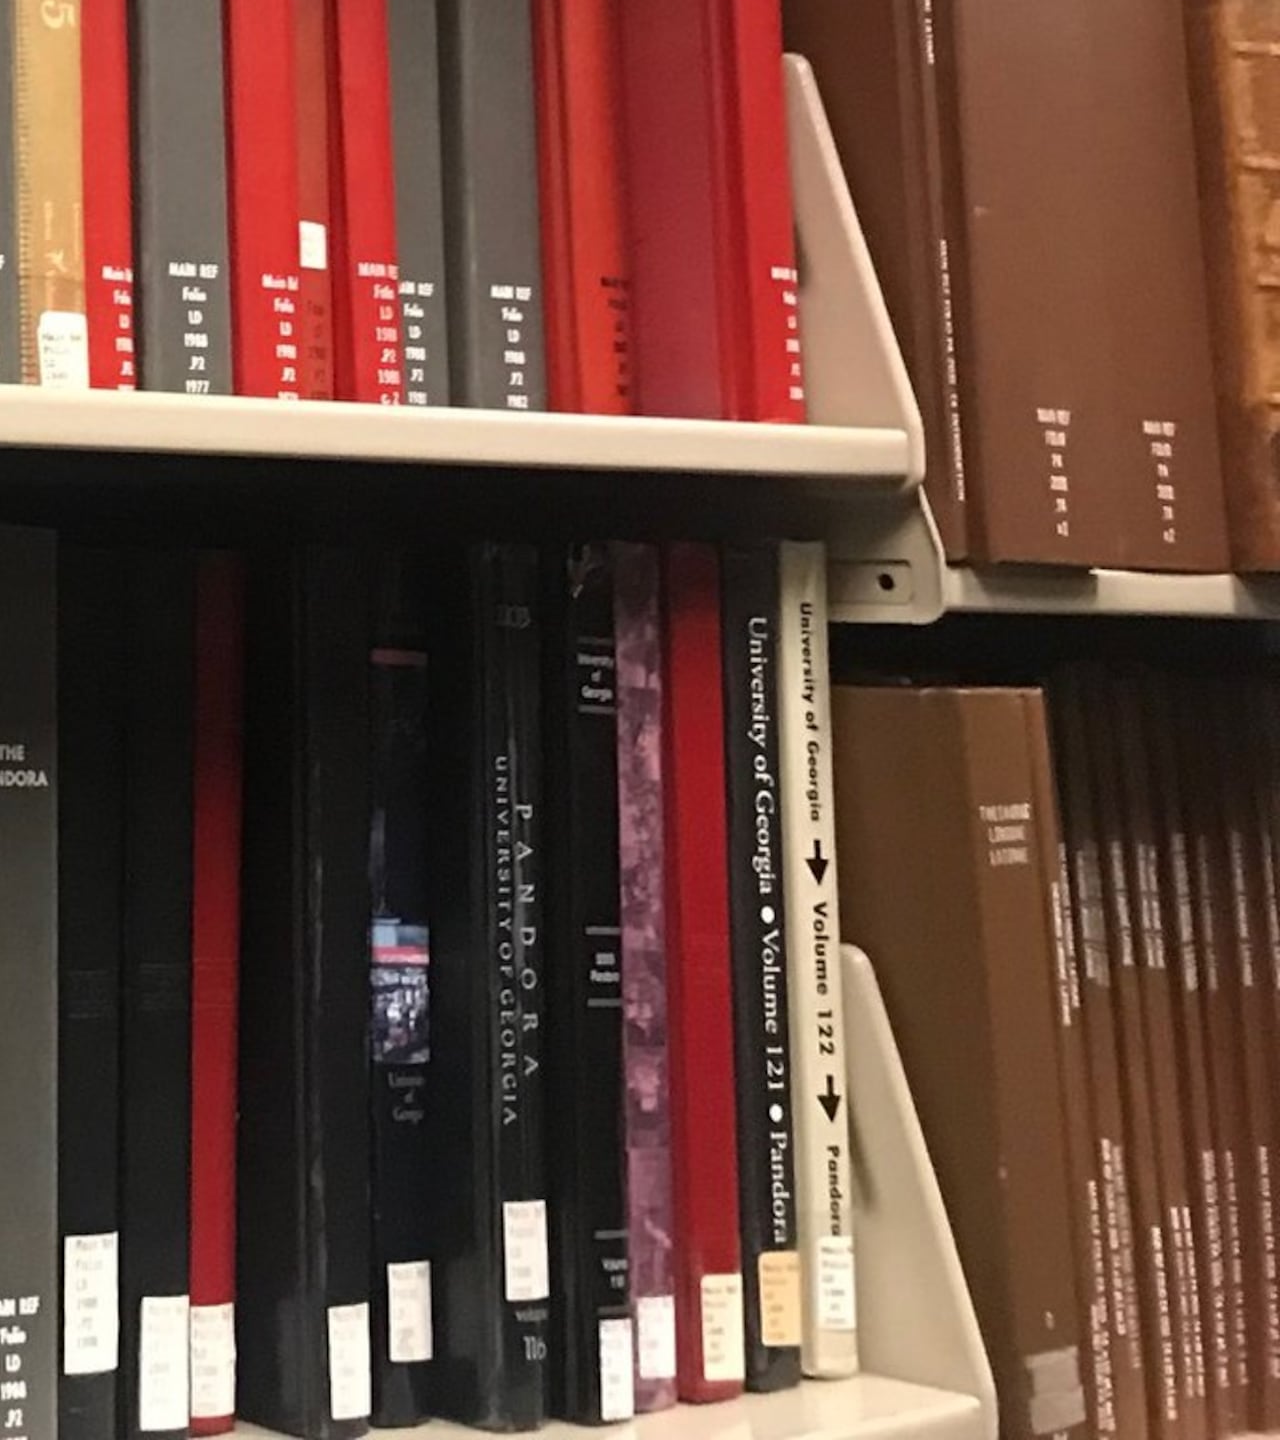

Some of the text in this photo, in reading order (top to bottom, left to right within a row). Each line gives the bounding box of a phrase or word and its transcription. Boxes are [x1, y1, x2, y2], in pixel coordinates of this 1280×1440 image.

[495, 756, 518, 1126] UNIVERSITY OF GEORGIA
[516, 804, 538, 1076] PANDORA
[747, 617, 790, 1244] University of Georgia Volume 121 Pandora
[800, 602, 842, 1236] University of Georgia Volume 122 Pandora
